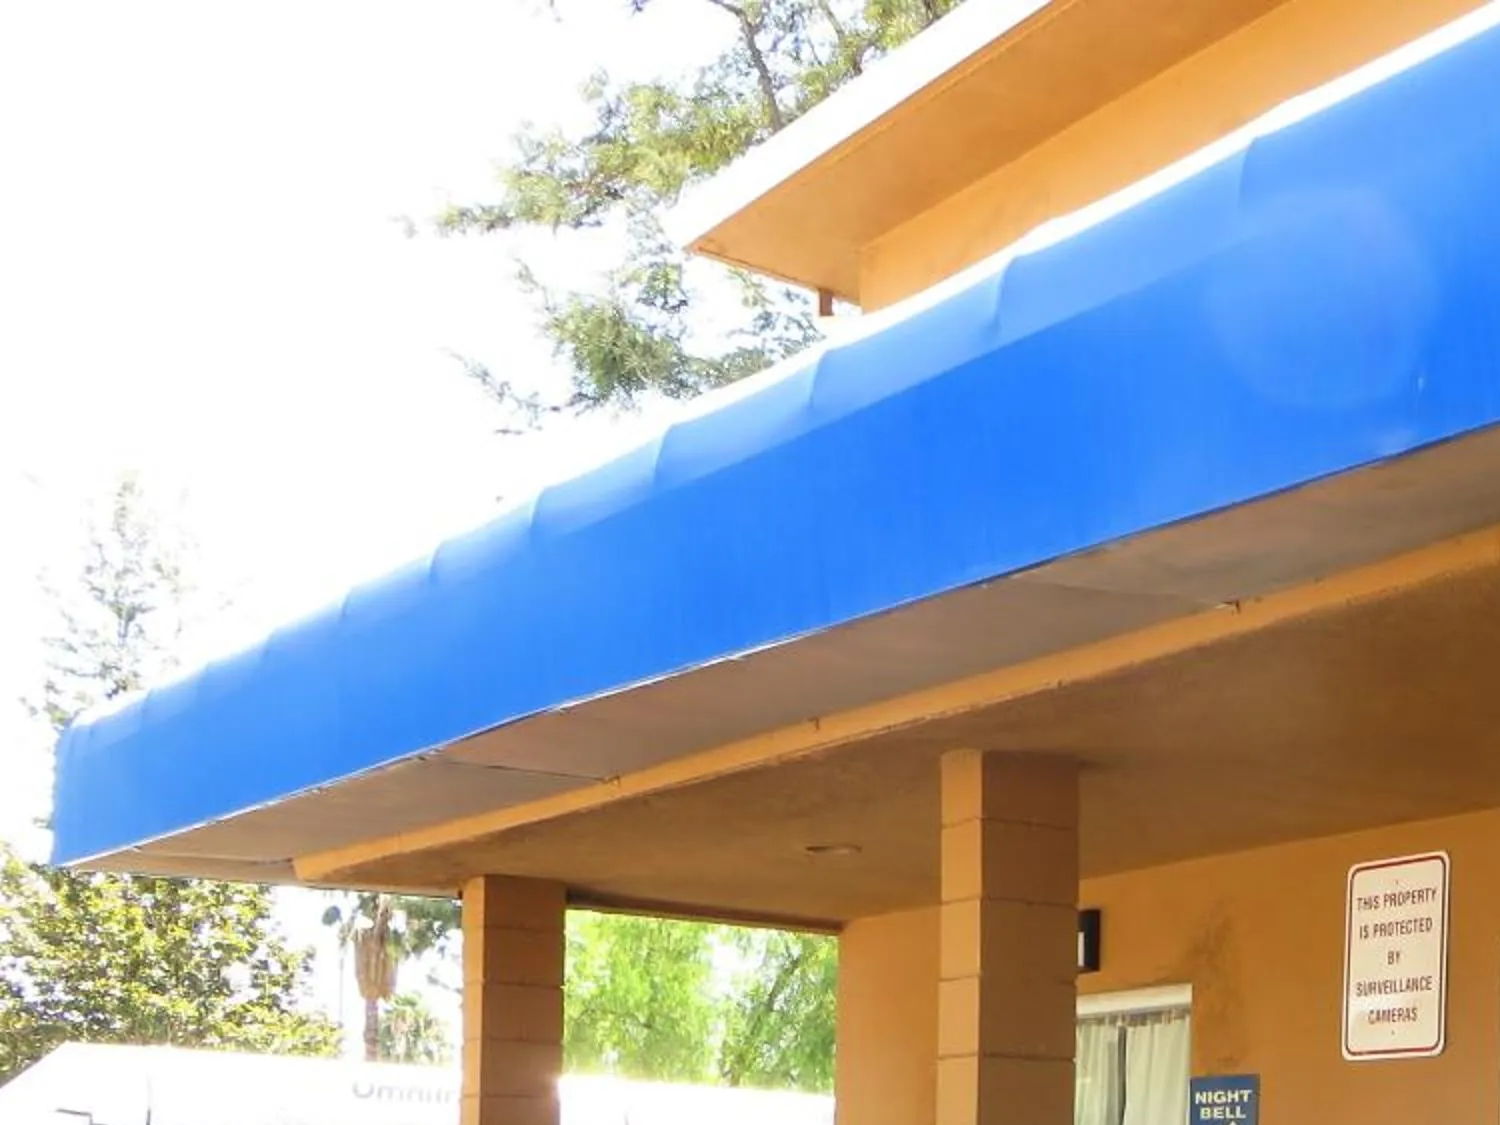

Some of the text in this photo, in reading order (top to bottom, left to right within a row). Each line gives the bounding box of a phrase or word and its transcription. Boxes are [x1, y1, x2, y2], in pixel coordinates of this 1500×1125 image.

[1357, 887, 1437, 911] THIS PROPERTY
[1359, 917, 1433, 939] IS PROTECTED
[1387, 951, 1401, 965] BY
[1356, 976, 1433, 997] SURVEILLANCE
[1368, 1007, 1417, 1025] CAMERAS
[1195, 1089, 1252, 1104] NIGHT
[1200, 1106, 1247, 1119] BELL
